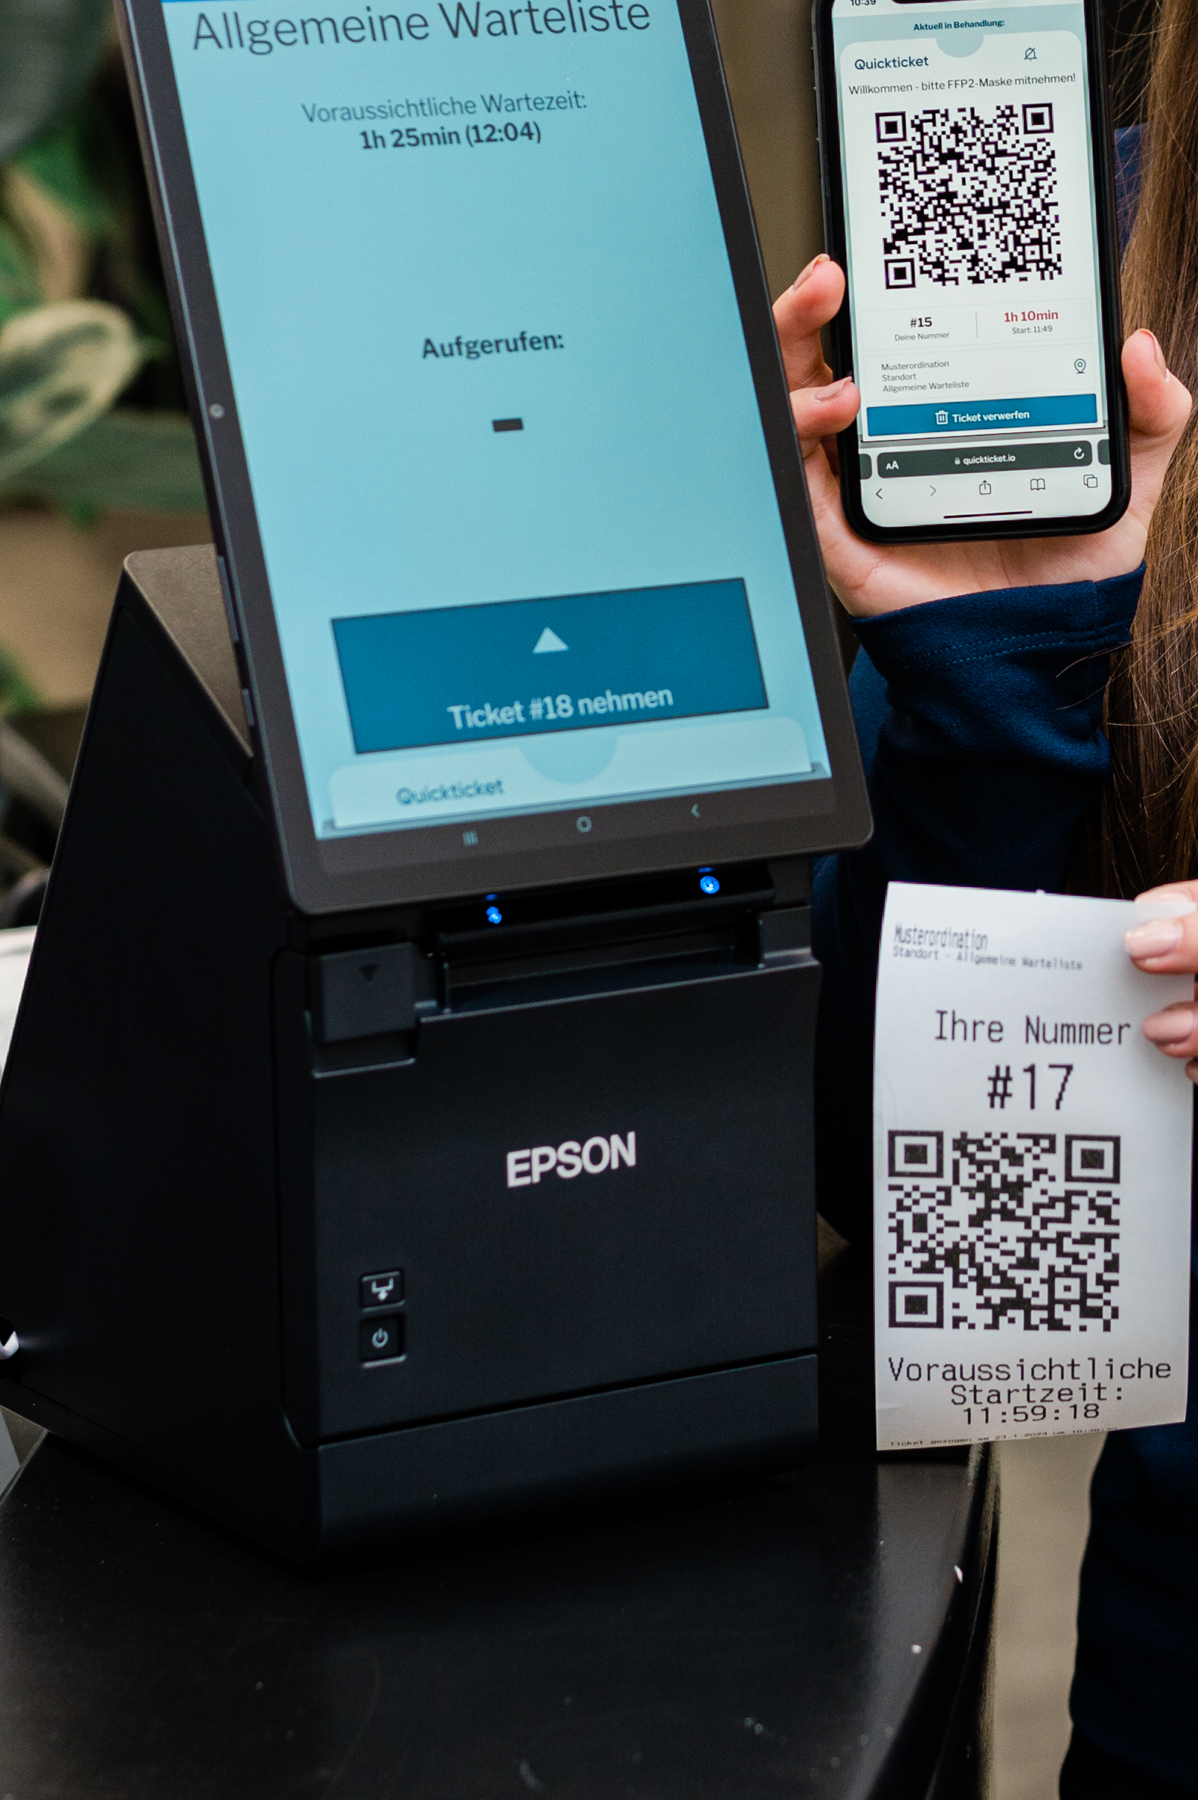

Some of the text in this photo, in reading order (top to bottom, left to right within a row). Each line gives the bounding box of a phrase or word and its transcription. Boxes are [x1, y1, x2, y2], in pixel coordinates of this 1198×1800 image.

[192, 5, 430, 56] Allgemeine
[913, 19, 1006, 31] Aktuell in Behandlung:
[854, 56, 929, 71] Quickticket
[848, 83, 913, 96] Willkommen
[921, 80, 946, 91] bitte
[948, 77, 1013, 90] FFP2-Maske
[1014, 73, 1076, 86] mitnehmen!
[300, 89, 588, 124] Voraussichtliche Wartezeit:
[360, 121, 542, 151] 1h 25min (12:04)
[910, 316, 932, 328] #15
[1004, 309, 1059, 323] 1h 10min
[894, 331, 950, 342] Deine Nummer
[1011, 325, 1053, 335] Start: 11:49
[422, 329, 565, 362] Aufgerufen:
[881, 360, 950, 371] Musterordination
[882, 372, 917, 382] Standort
[882, 380, 970, 394] Allgemeine Warteliste
[952, 410, 1030, 423] Ticket verwerfen
[963, 454, 1016, 466] quickticket.io
[446, 685, 674, 731] Ticket #18 nehmen
[396, 778, 505, 806] Quickticket
[893, 923, 989, 951] Musterordination
[892, 946, 939, 962] Standort
[955, 951, 1017, 968] Allgemeine
[1021, 957, 1084, 972] Warteliste
[934, 1009, 1132, 1046] Ihre Nummer
[987, 1063, 1074, 1111] #17
[506, 1131, 637, 1188] EPSON
[888, 1356, 1172, 1382] Voraussichtliche
[950, 1382, 1124, 1406] Startzeit:
[962, 1403, 1100, 1426] 11:59:18
